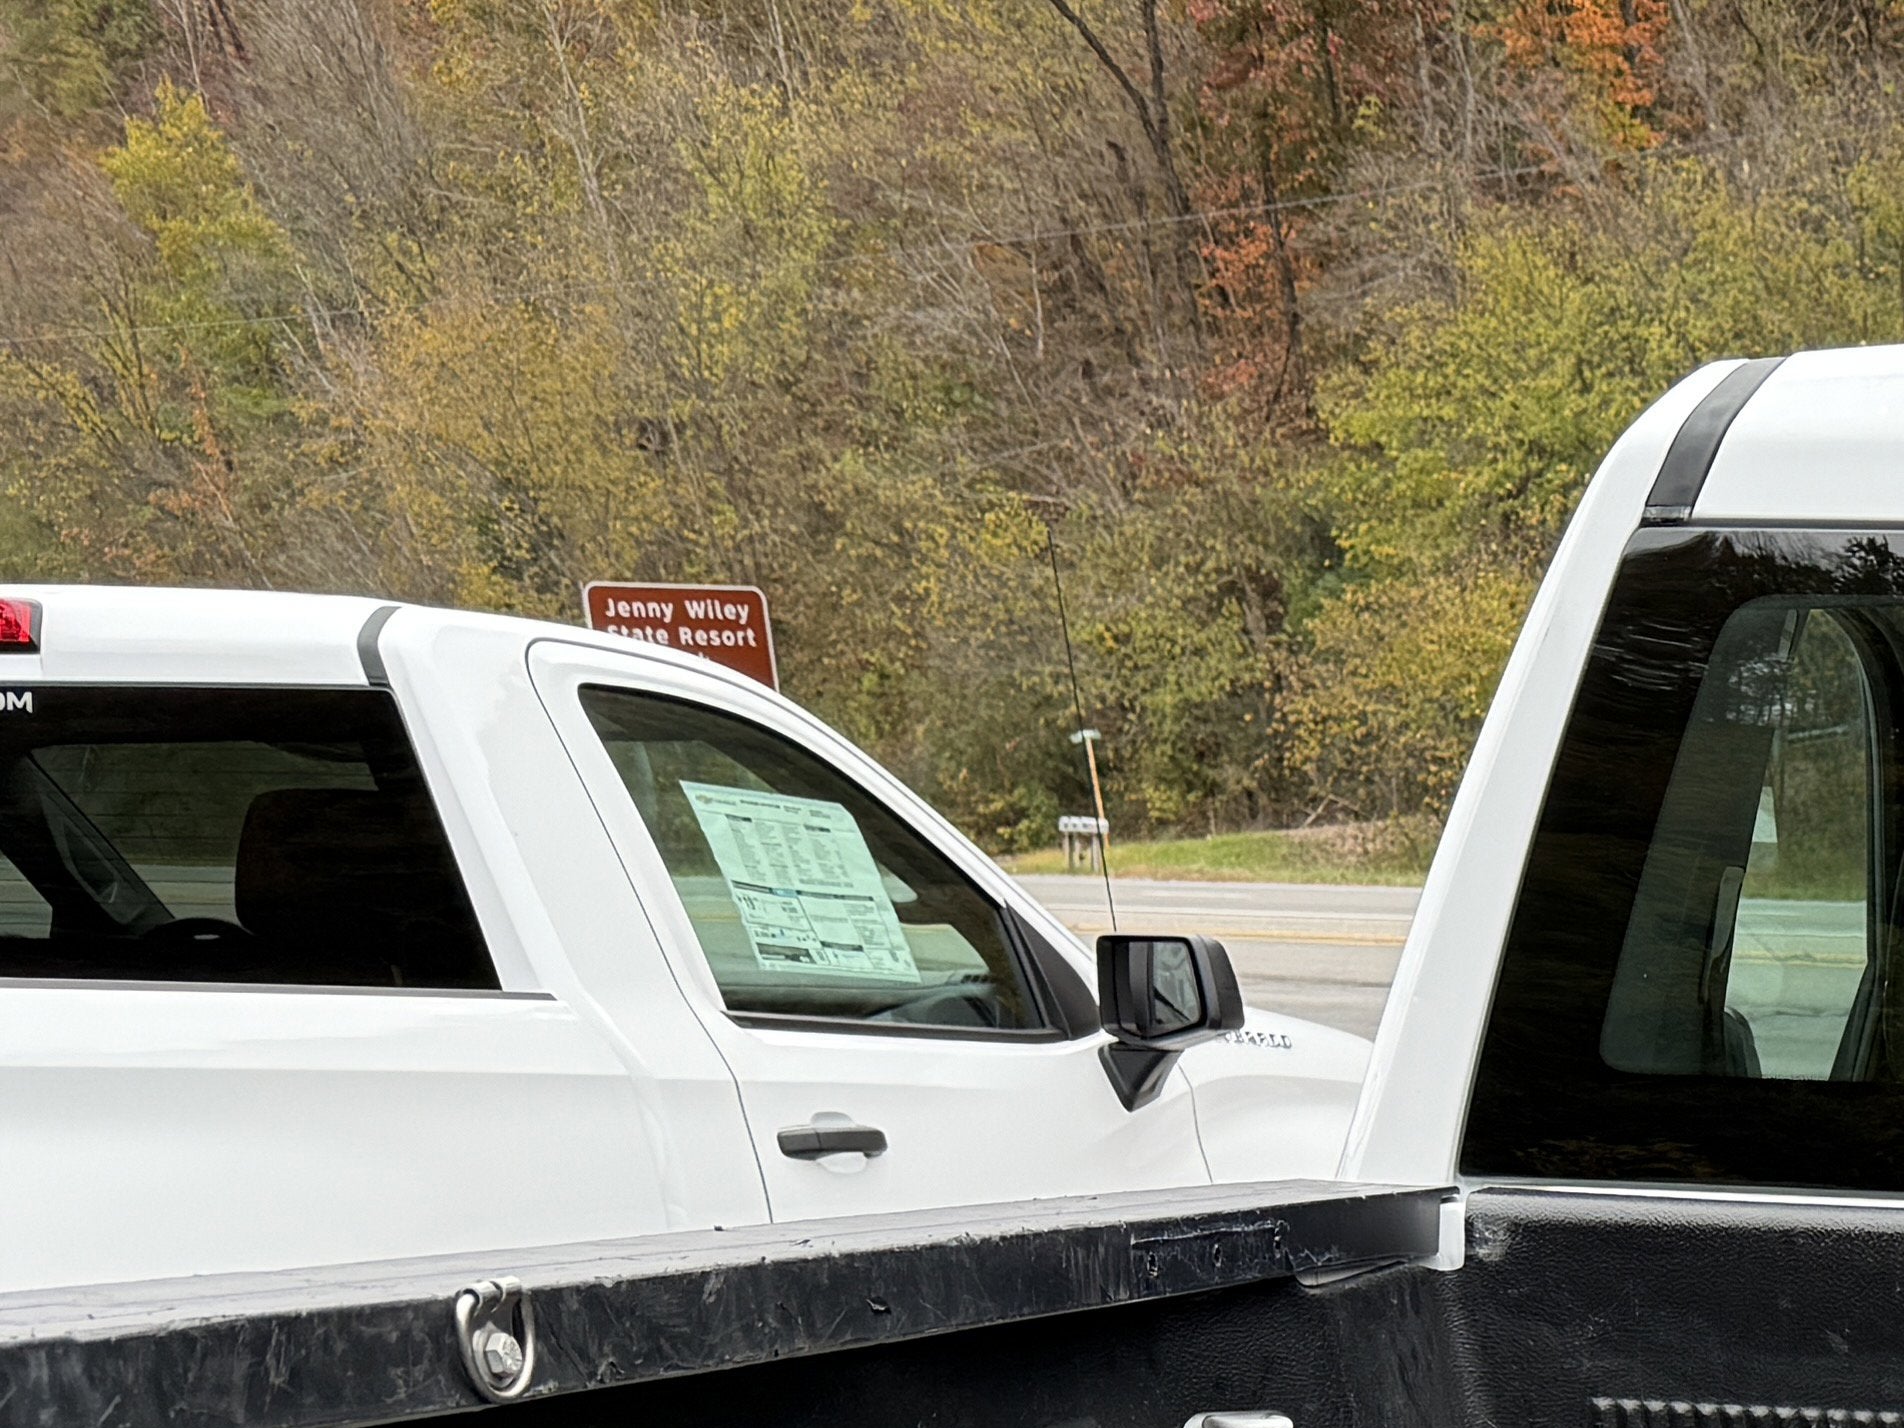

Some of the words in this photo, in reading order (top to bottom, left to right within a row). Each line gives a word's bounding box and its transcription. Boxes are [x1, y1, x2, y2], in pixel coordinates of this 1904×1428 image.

[605, 598, 673, 623] Jenny
[684, 599, 749, 625] Wiley
[678, 626, 758, 648] Resort
